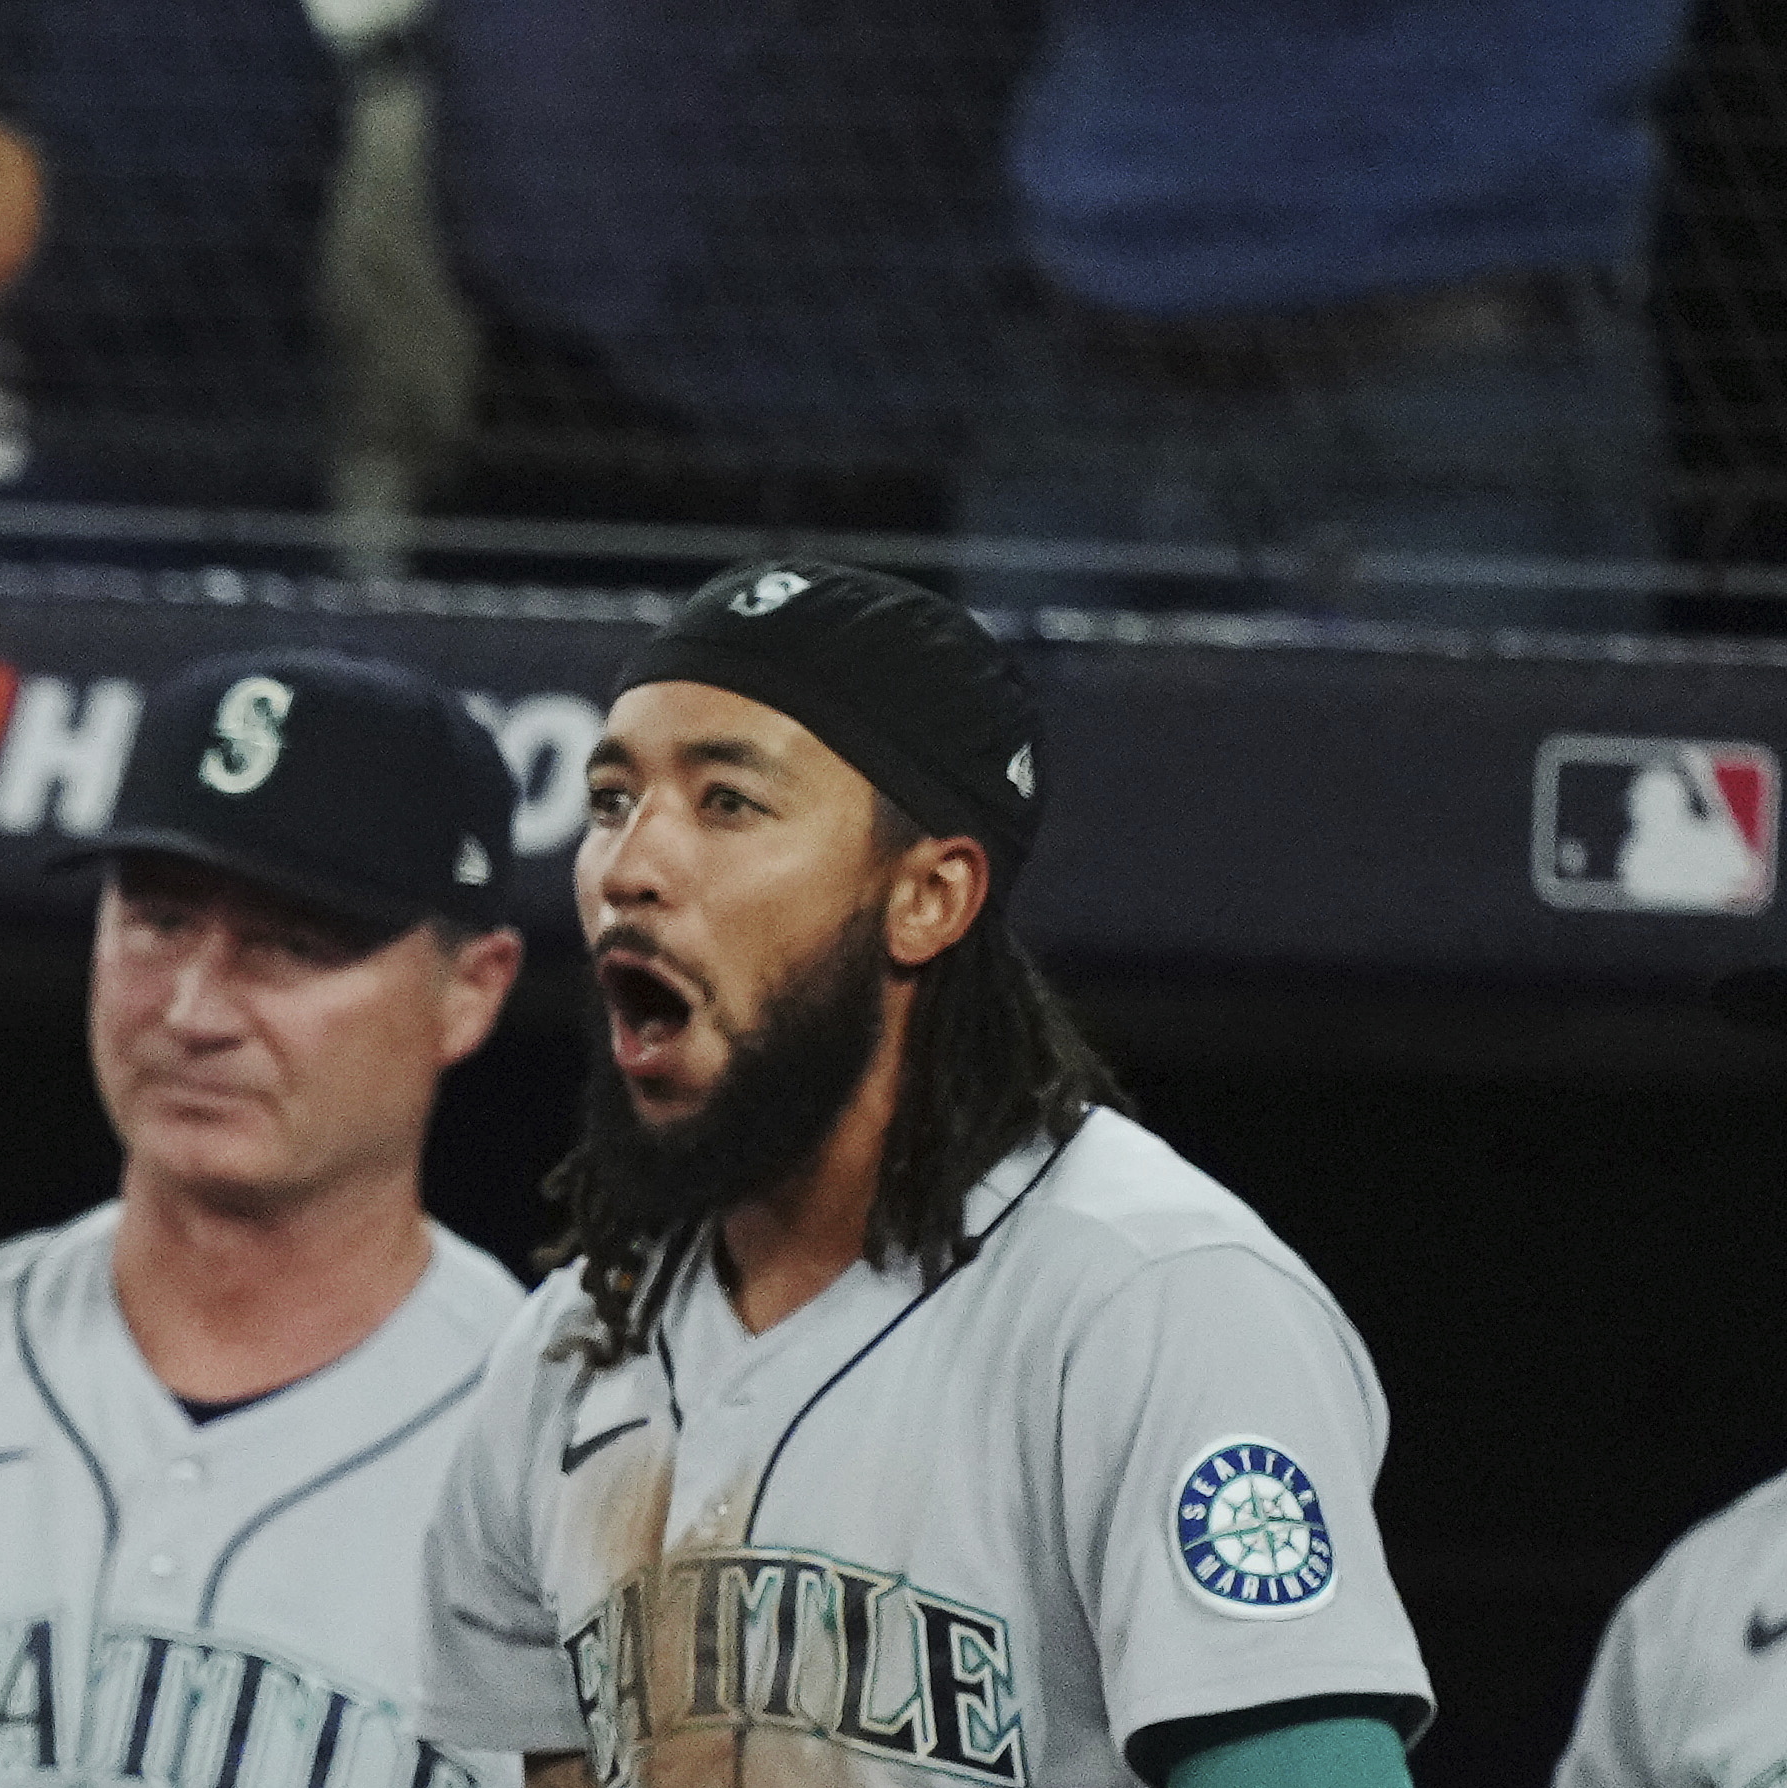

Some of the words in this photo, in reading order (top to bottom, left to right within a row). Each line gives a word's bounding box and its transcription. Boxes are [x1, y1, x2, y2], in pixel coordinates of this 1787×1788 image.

[729, 569, 811, 617] S
[198, 674, 293, 796] S
[1181, 1448, 1315, 1520] SEATTLE
